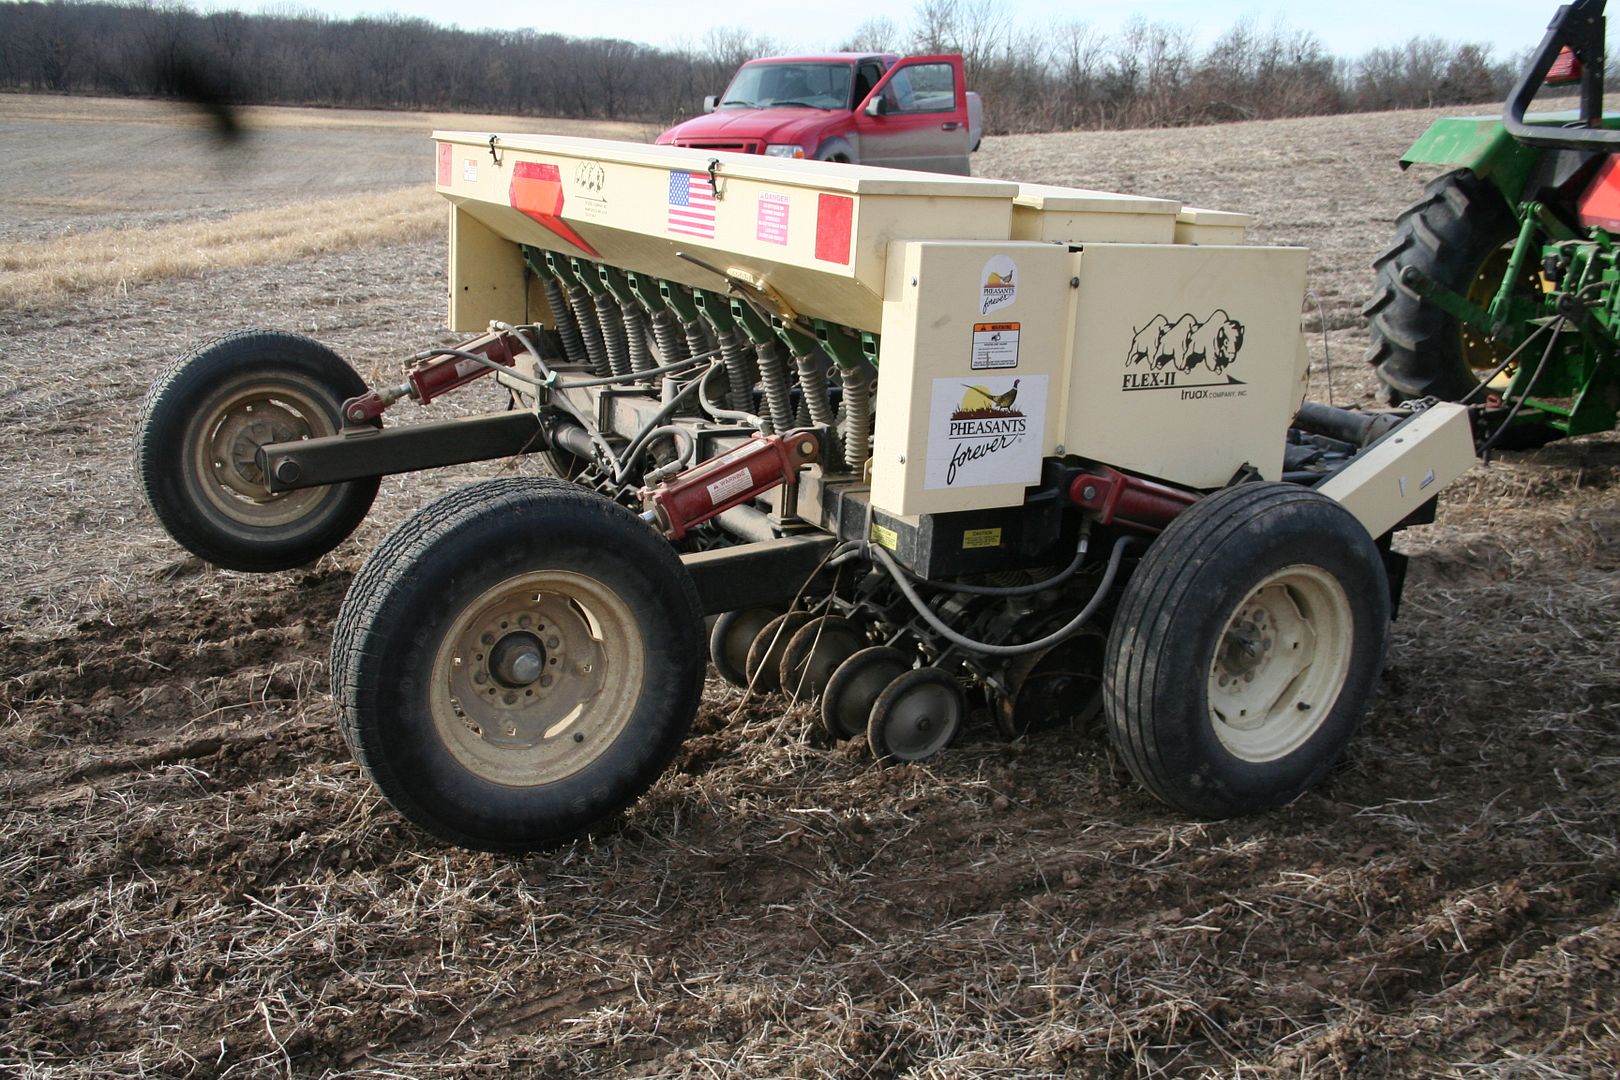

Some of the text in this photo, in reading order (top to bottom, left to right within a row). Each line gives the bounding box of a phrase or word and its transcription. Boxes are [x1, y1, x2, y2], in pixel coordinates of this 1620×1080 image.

[765, 192, 789, 203] DANGER
[982, 294, 1012, 315] forever
[1122, 372, 1176, 388] FLEX-II
[949, 419, 1026, 435] PHEASANTS
[947, 434, 1018, 485] forever
[720, 471, 746, 486] WARNING
